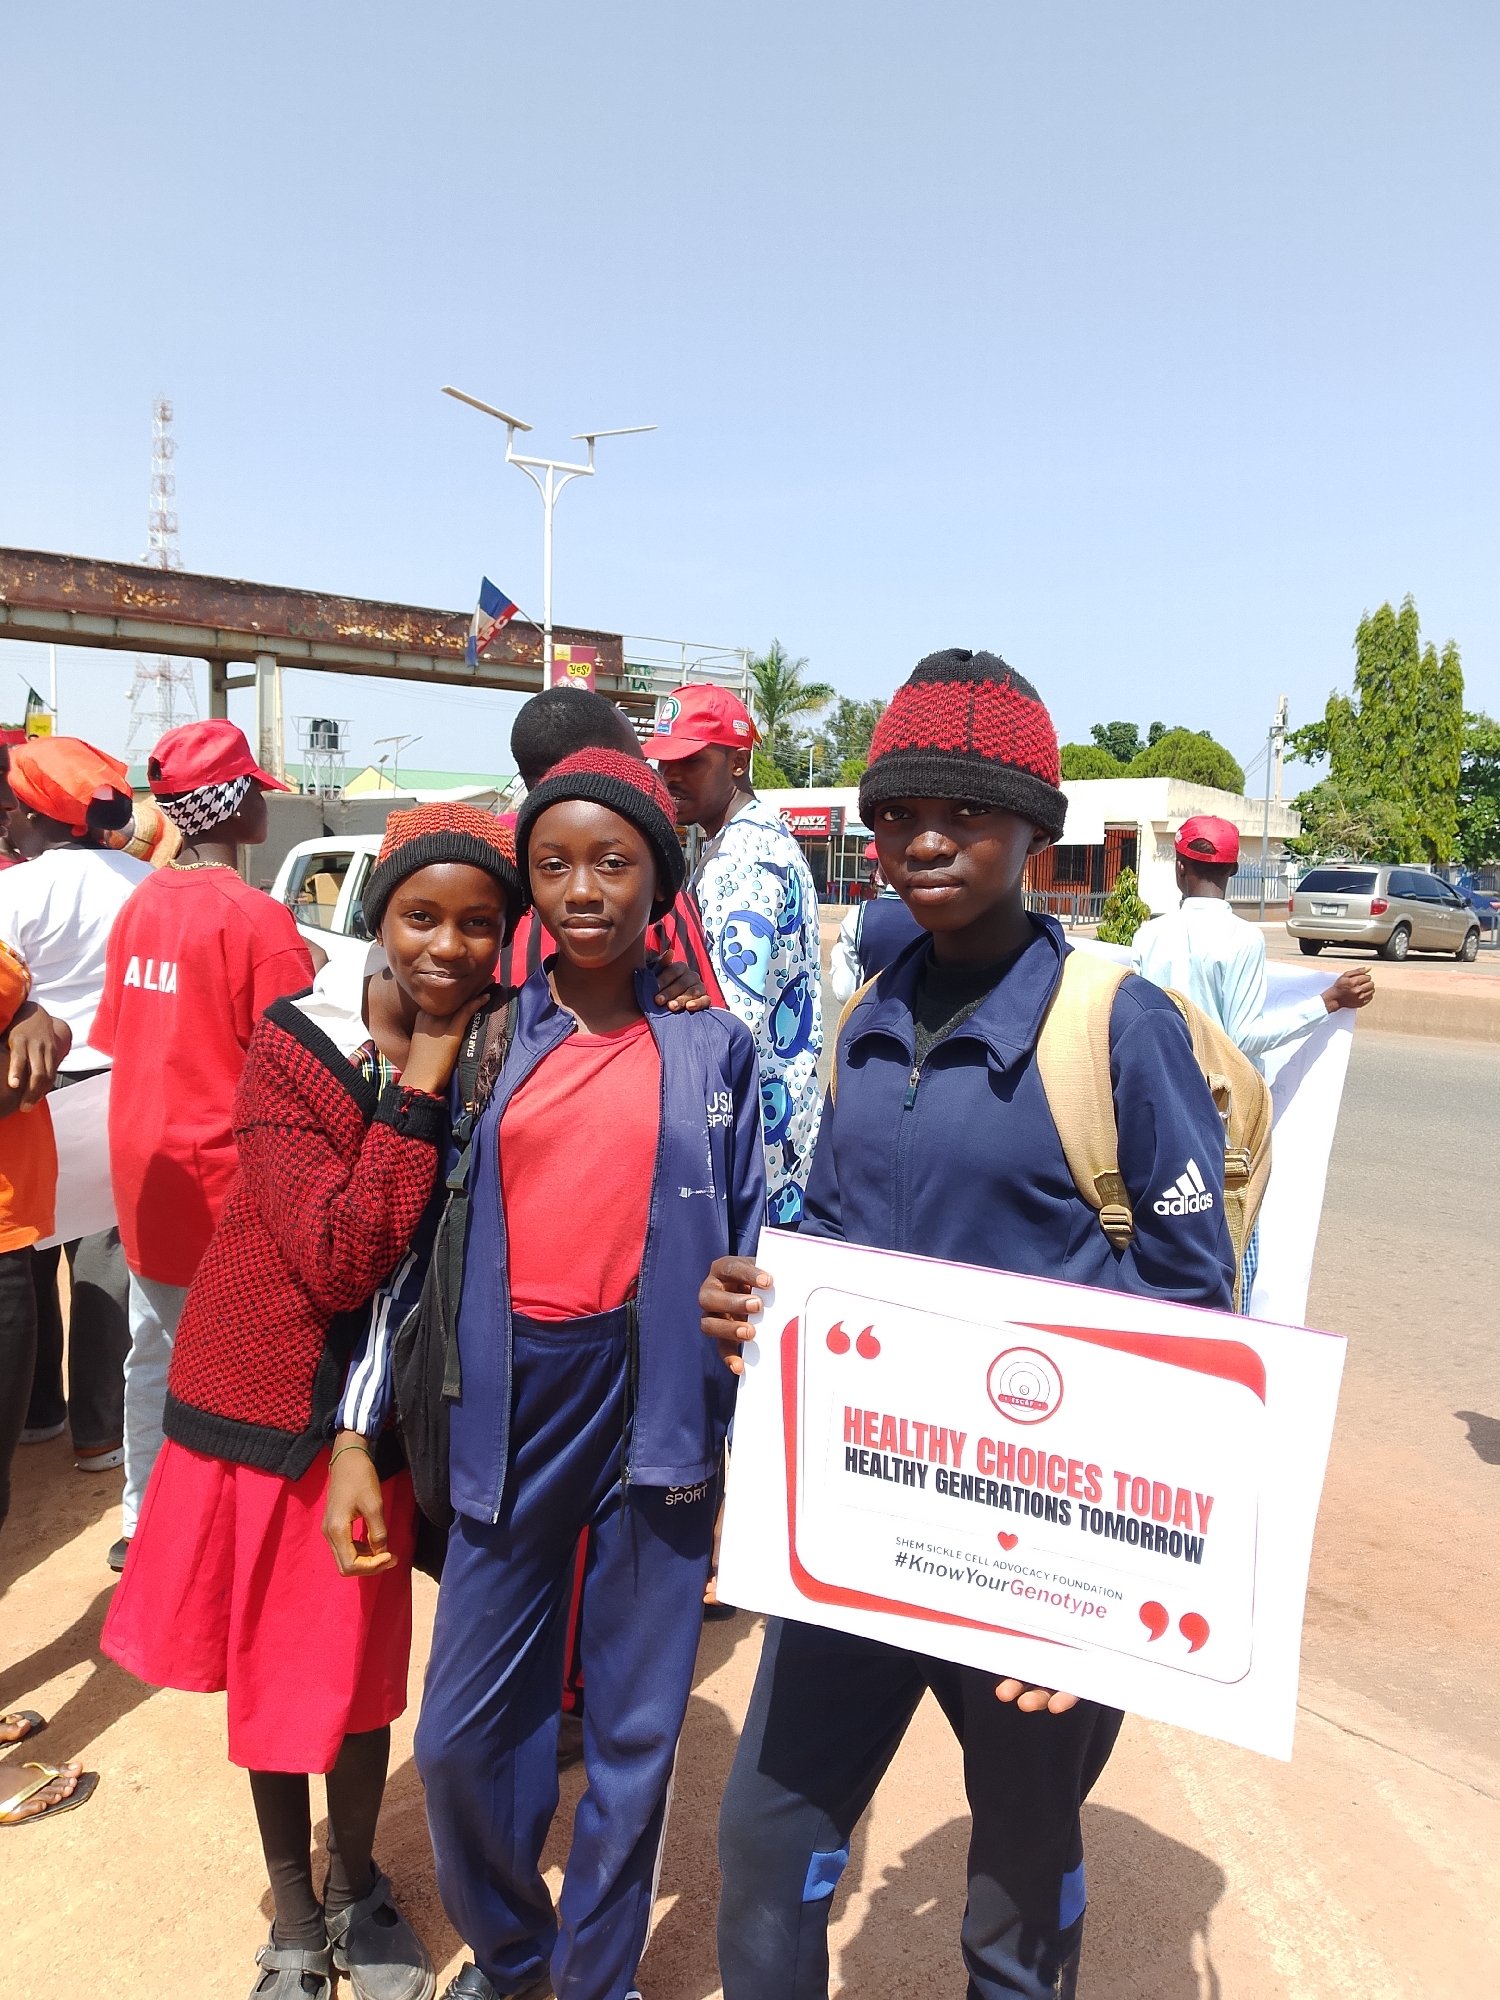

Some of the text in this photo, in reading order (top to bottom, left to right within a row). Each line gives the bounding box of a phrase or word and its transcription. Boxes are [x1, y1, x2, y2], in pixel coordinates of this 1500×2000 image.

[466, 1040, 476, 1058] STAR
[1153, 1192, 1213, 1216] adidas
[665, 1486, 708, 1506] SPORT
[844, 1405, 1215, 1535] HEALTHY CHOICES TODAY
[845, 1446, 1205, 1565] HEALTHY GENERATIONS TOMORROW
[894, 1551, 1107, 1619] #KnowYourGenotype
[895, 1536, 1123, 1601] SHEM SICKLE CELL ADVOCACY FOUNDATION
